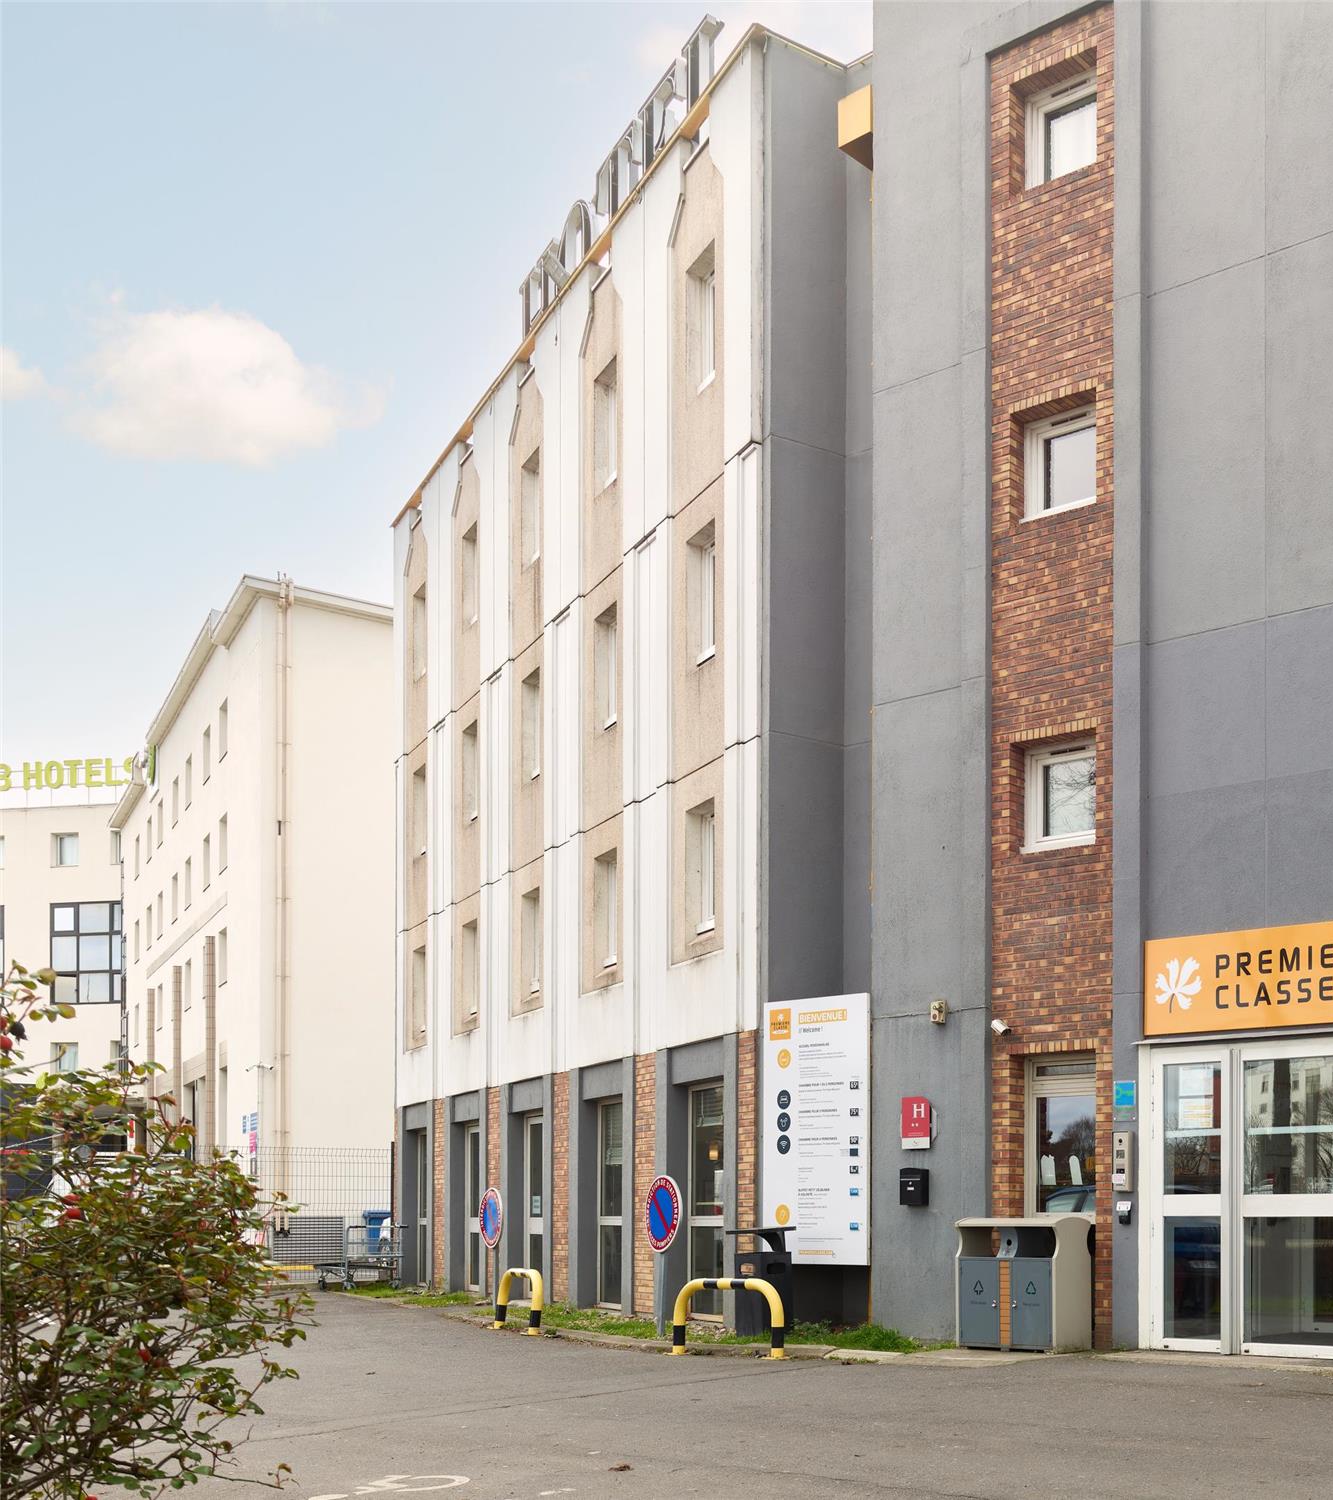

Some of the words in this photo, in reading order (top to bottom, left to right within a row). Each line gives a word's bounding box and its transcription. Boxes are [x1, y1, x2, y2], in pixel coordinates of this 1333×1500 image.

[1215, 976, 1333, 1010] CLASSE
[912, 1103, 925, 1119] H
[666, 1182, 679, 1225] STATIONNER
